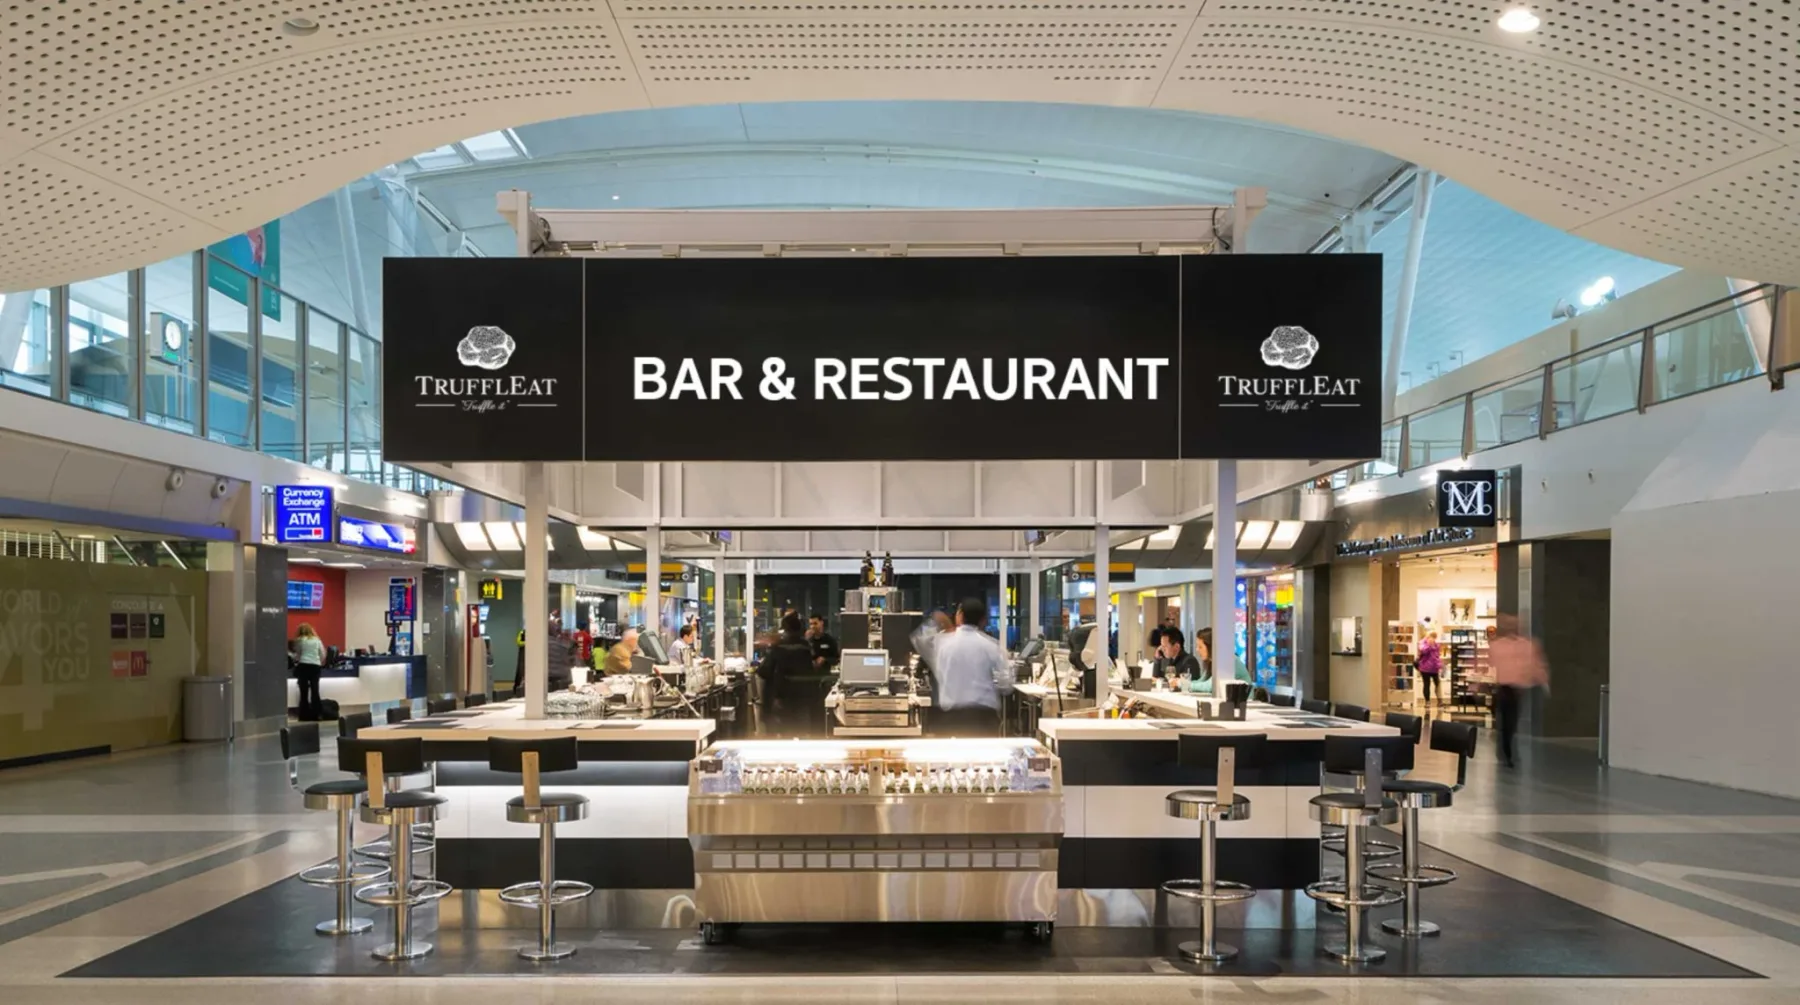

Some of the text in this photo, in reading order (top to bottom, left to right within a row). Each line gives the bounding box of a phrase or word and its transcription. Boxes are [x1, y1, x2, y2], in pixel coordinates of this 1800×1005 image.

[633, 356, 1169, 401] BAR & RESTAURANT
[283, 488, 324, 499] Currency
[283, 497, 325, 507] Exchange
[289, 512, 321, 525] ATM
[0, 588, 62, 615] ORLD
[44, 655, 91, 683] YOU
